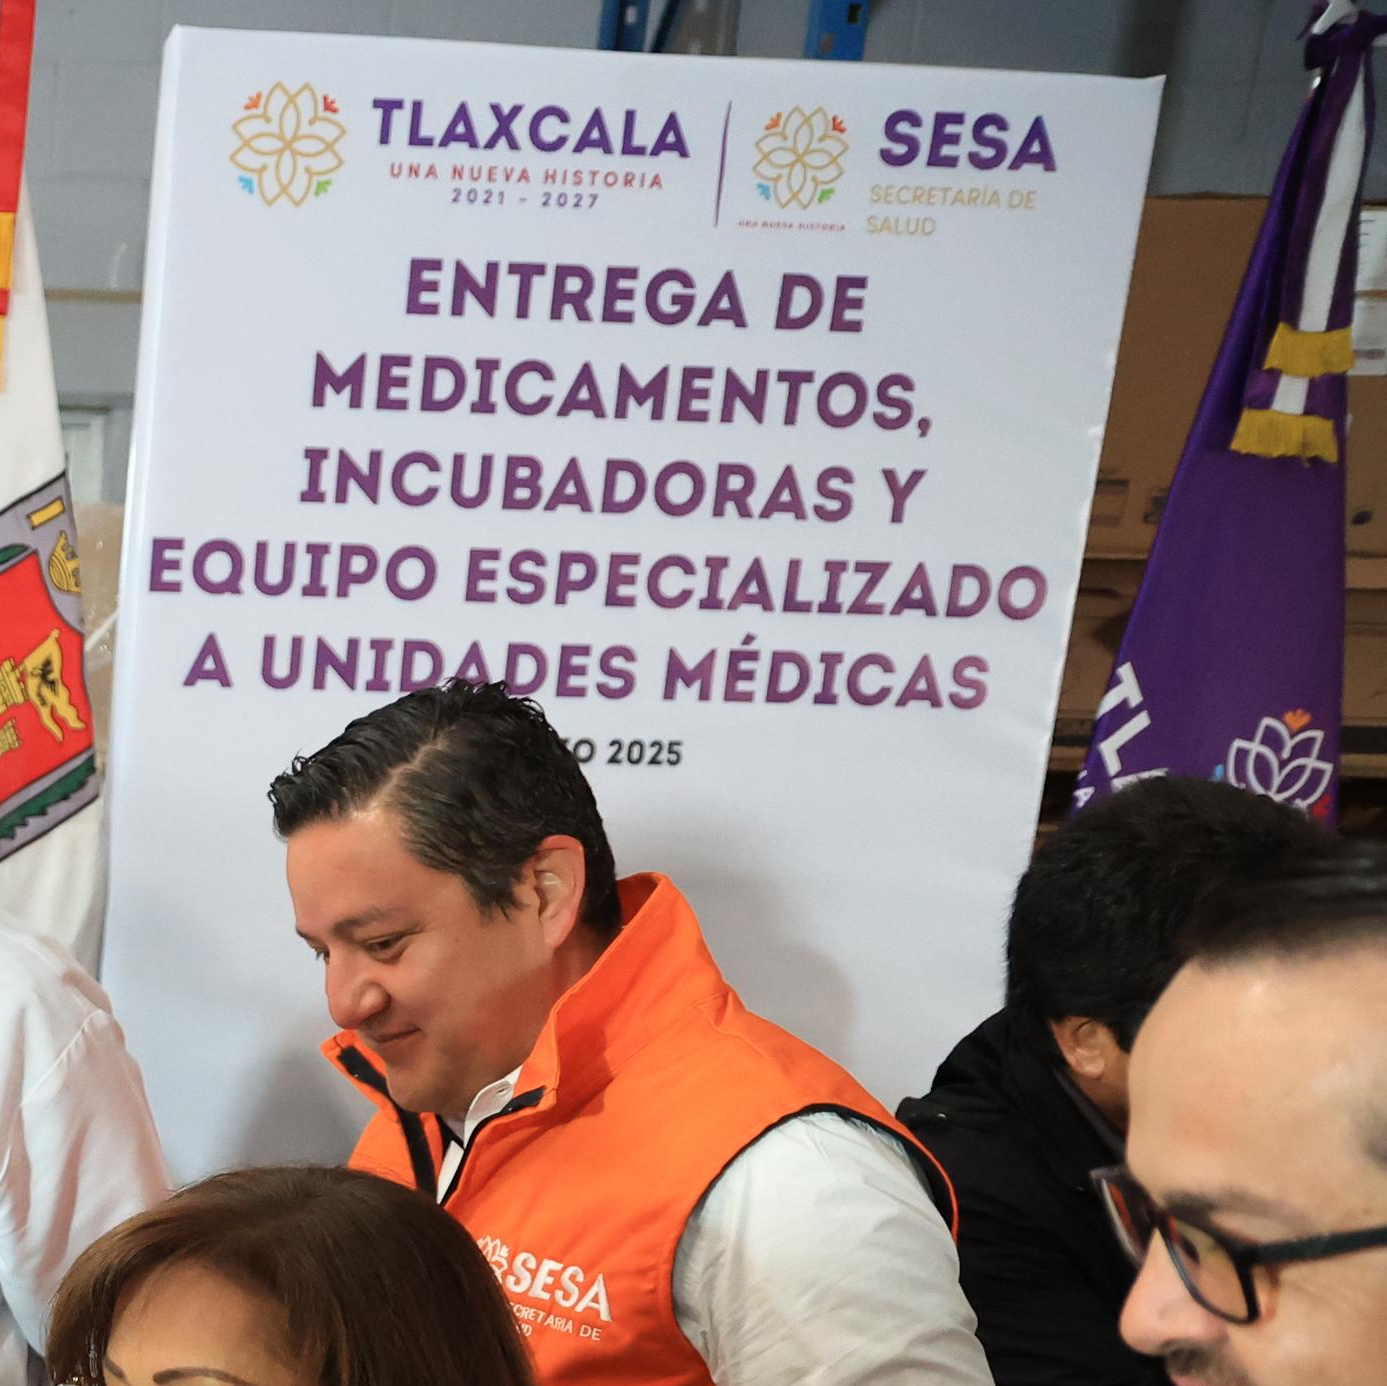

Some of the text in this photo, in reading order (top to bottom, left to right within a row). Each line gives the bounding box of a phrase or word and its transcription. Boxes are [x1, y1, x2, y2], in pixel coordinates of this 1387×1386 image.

[373, 98, 690, 158] TLAXCALA
[879, 108, 1058, 172] SESA
[389, 162, 664, 189] UNA NUEVA HISTORIA
[451, 188, 506, 205] 2021
[542, 191, 599, 209] 2027
[870, 184, 1038, 211] SECRETARÍA DE
[866, 215, 937, 237] SALUD
[405, 258, 869, 334] ENTREGA DE
[311, 352, 932, 438] MEDICAMENTOS,
[299, 447, 927, 524] INCUBADORAS Y
[149, 536, 1049, 620] EQUIPO ESPECIALIZADO
[182, 632, 991, 710] A UNIDADES MÉDICAS
[606, 738, 684, 766] 2025
[506, 1251, 613, 1322] SESA
[510, 1302, 574, 1334] CRETARIA
[579, 1324, 603, 1341] DE
